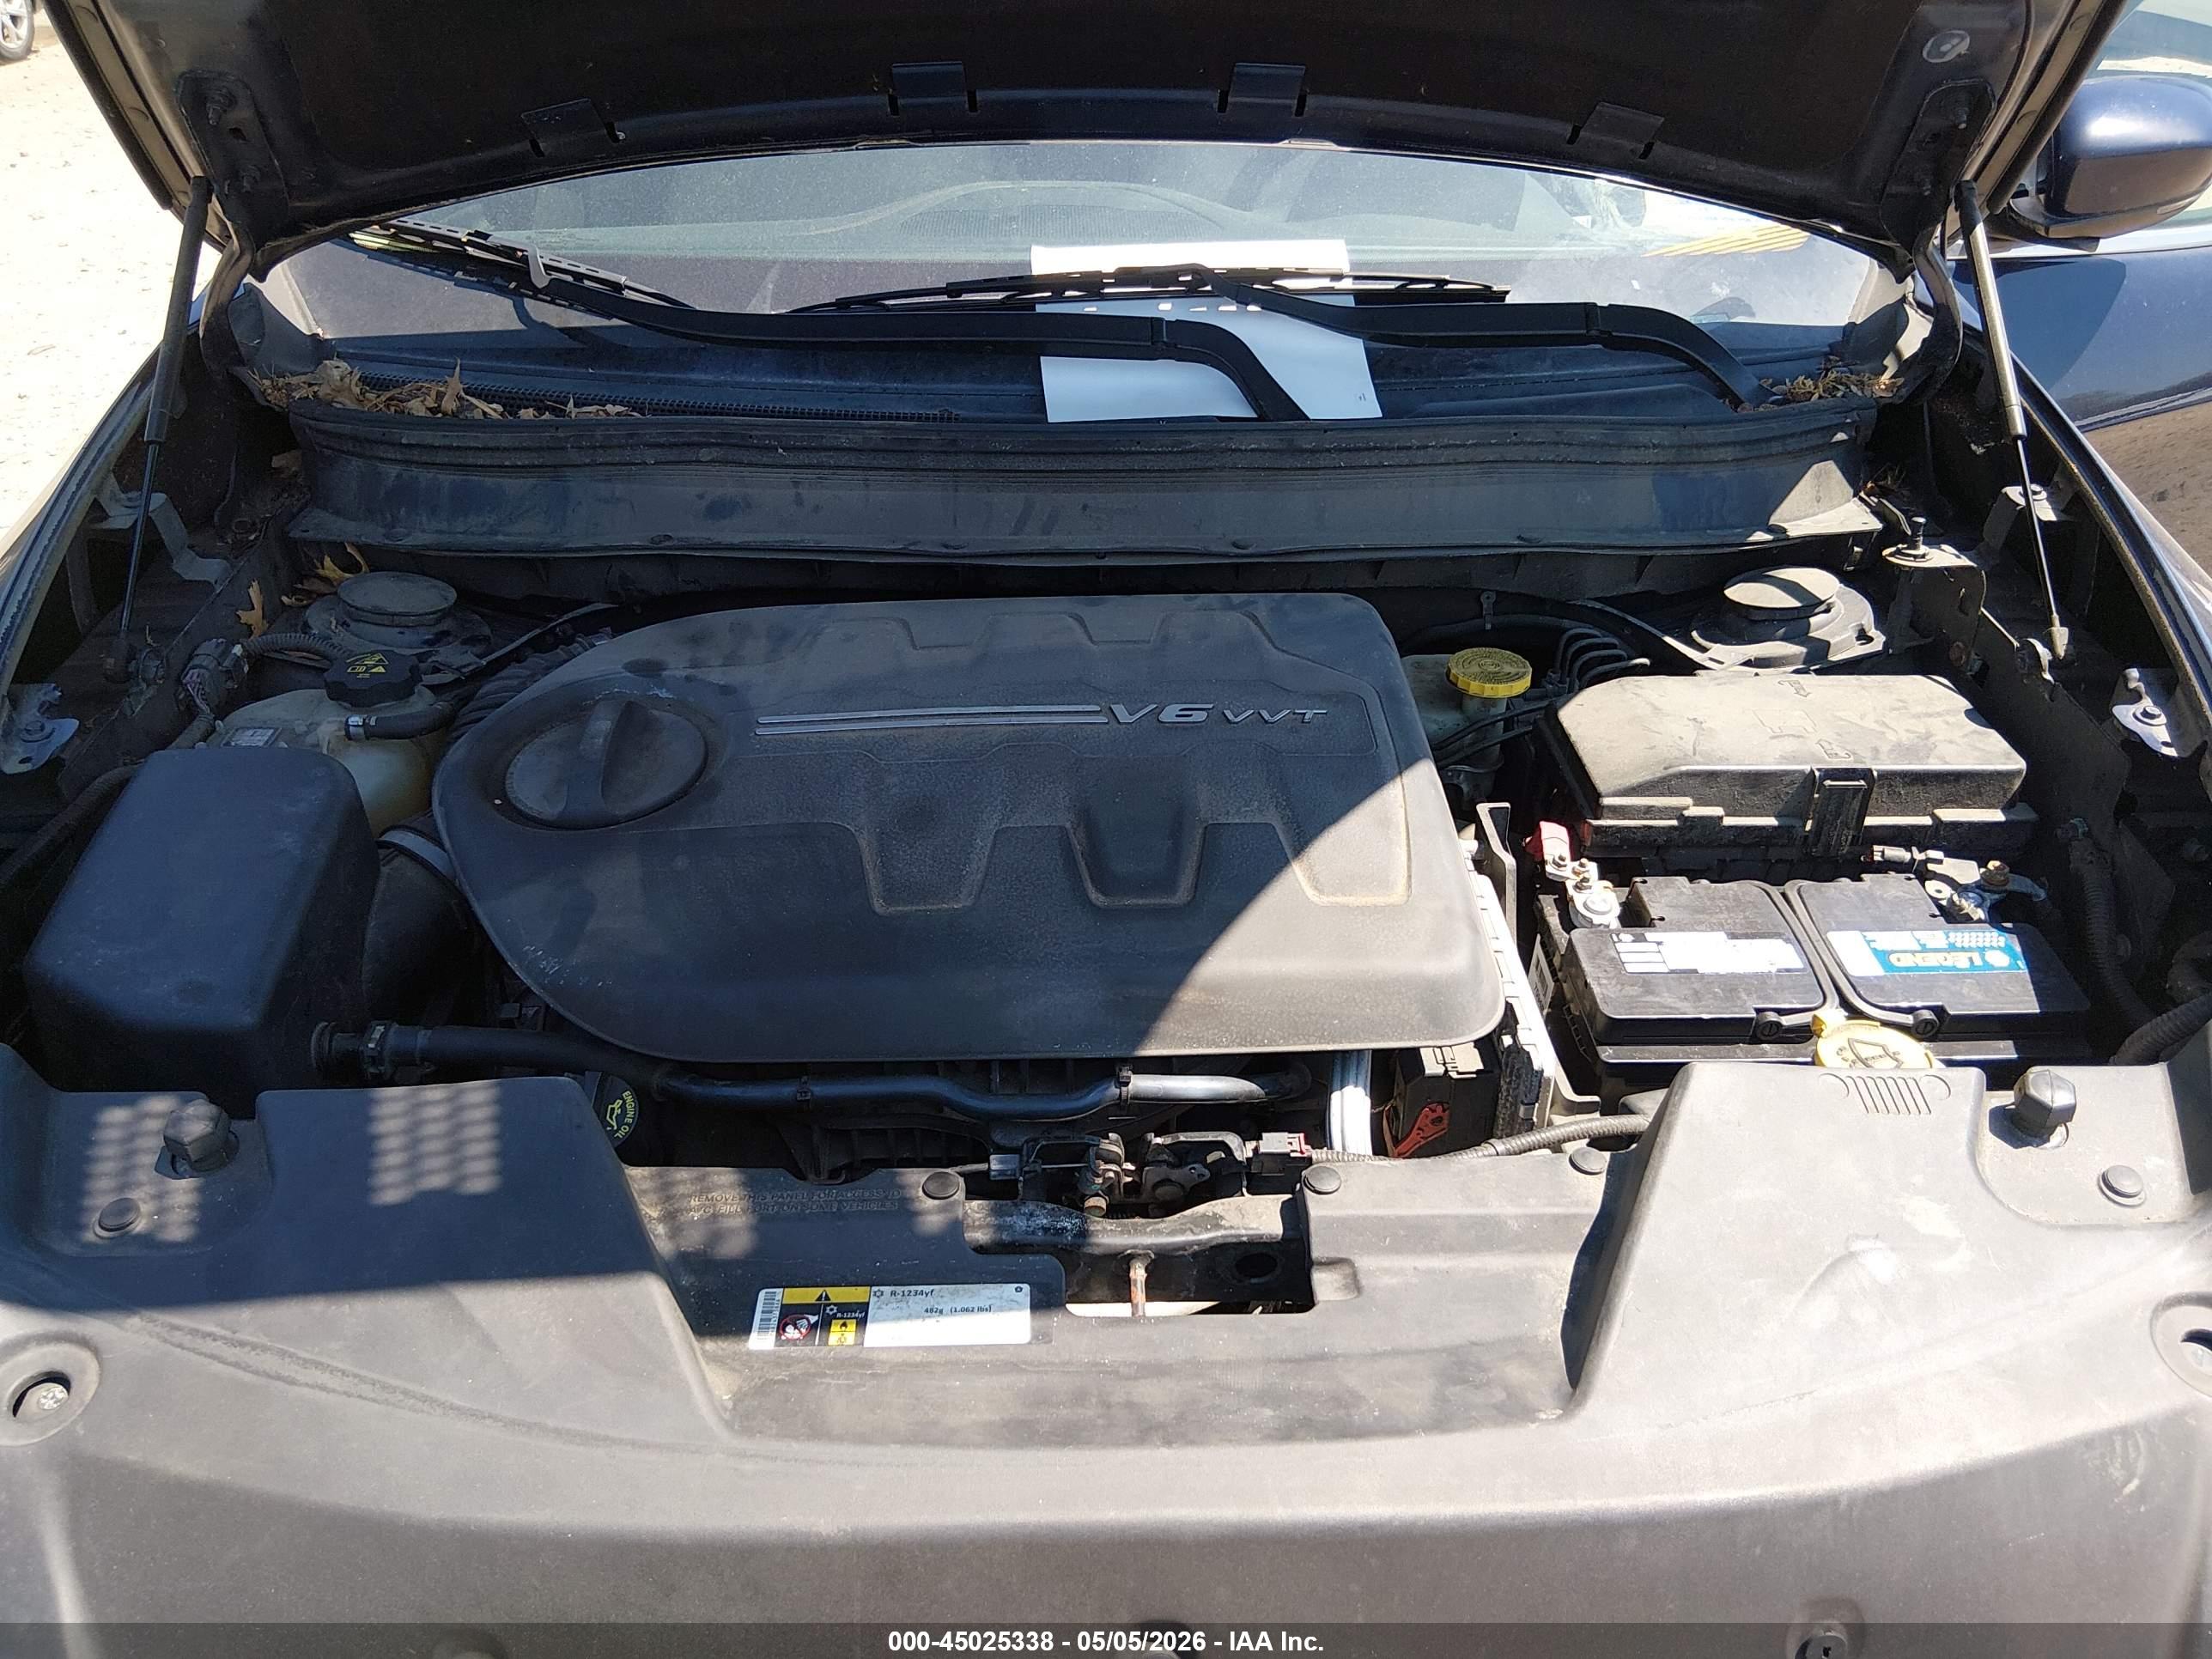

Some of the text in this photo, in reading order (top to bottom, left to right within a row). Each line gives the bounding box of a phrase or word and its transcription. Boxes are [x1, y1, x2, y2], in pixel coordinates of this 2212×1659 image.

[1109, 702, 1328, 723] V6 VVT
[614, 1091, 635, 1138] ENGINE OIL
[689, 1194, 740, 1203] REMOVE
[743, 1194, 768, 1202] THIS
[771, 1191, 808, 1202] PANEL
[718, 1204, 743, 1214] FILL
[890, 1288, 935, 1298] R-1234yf
